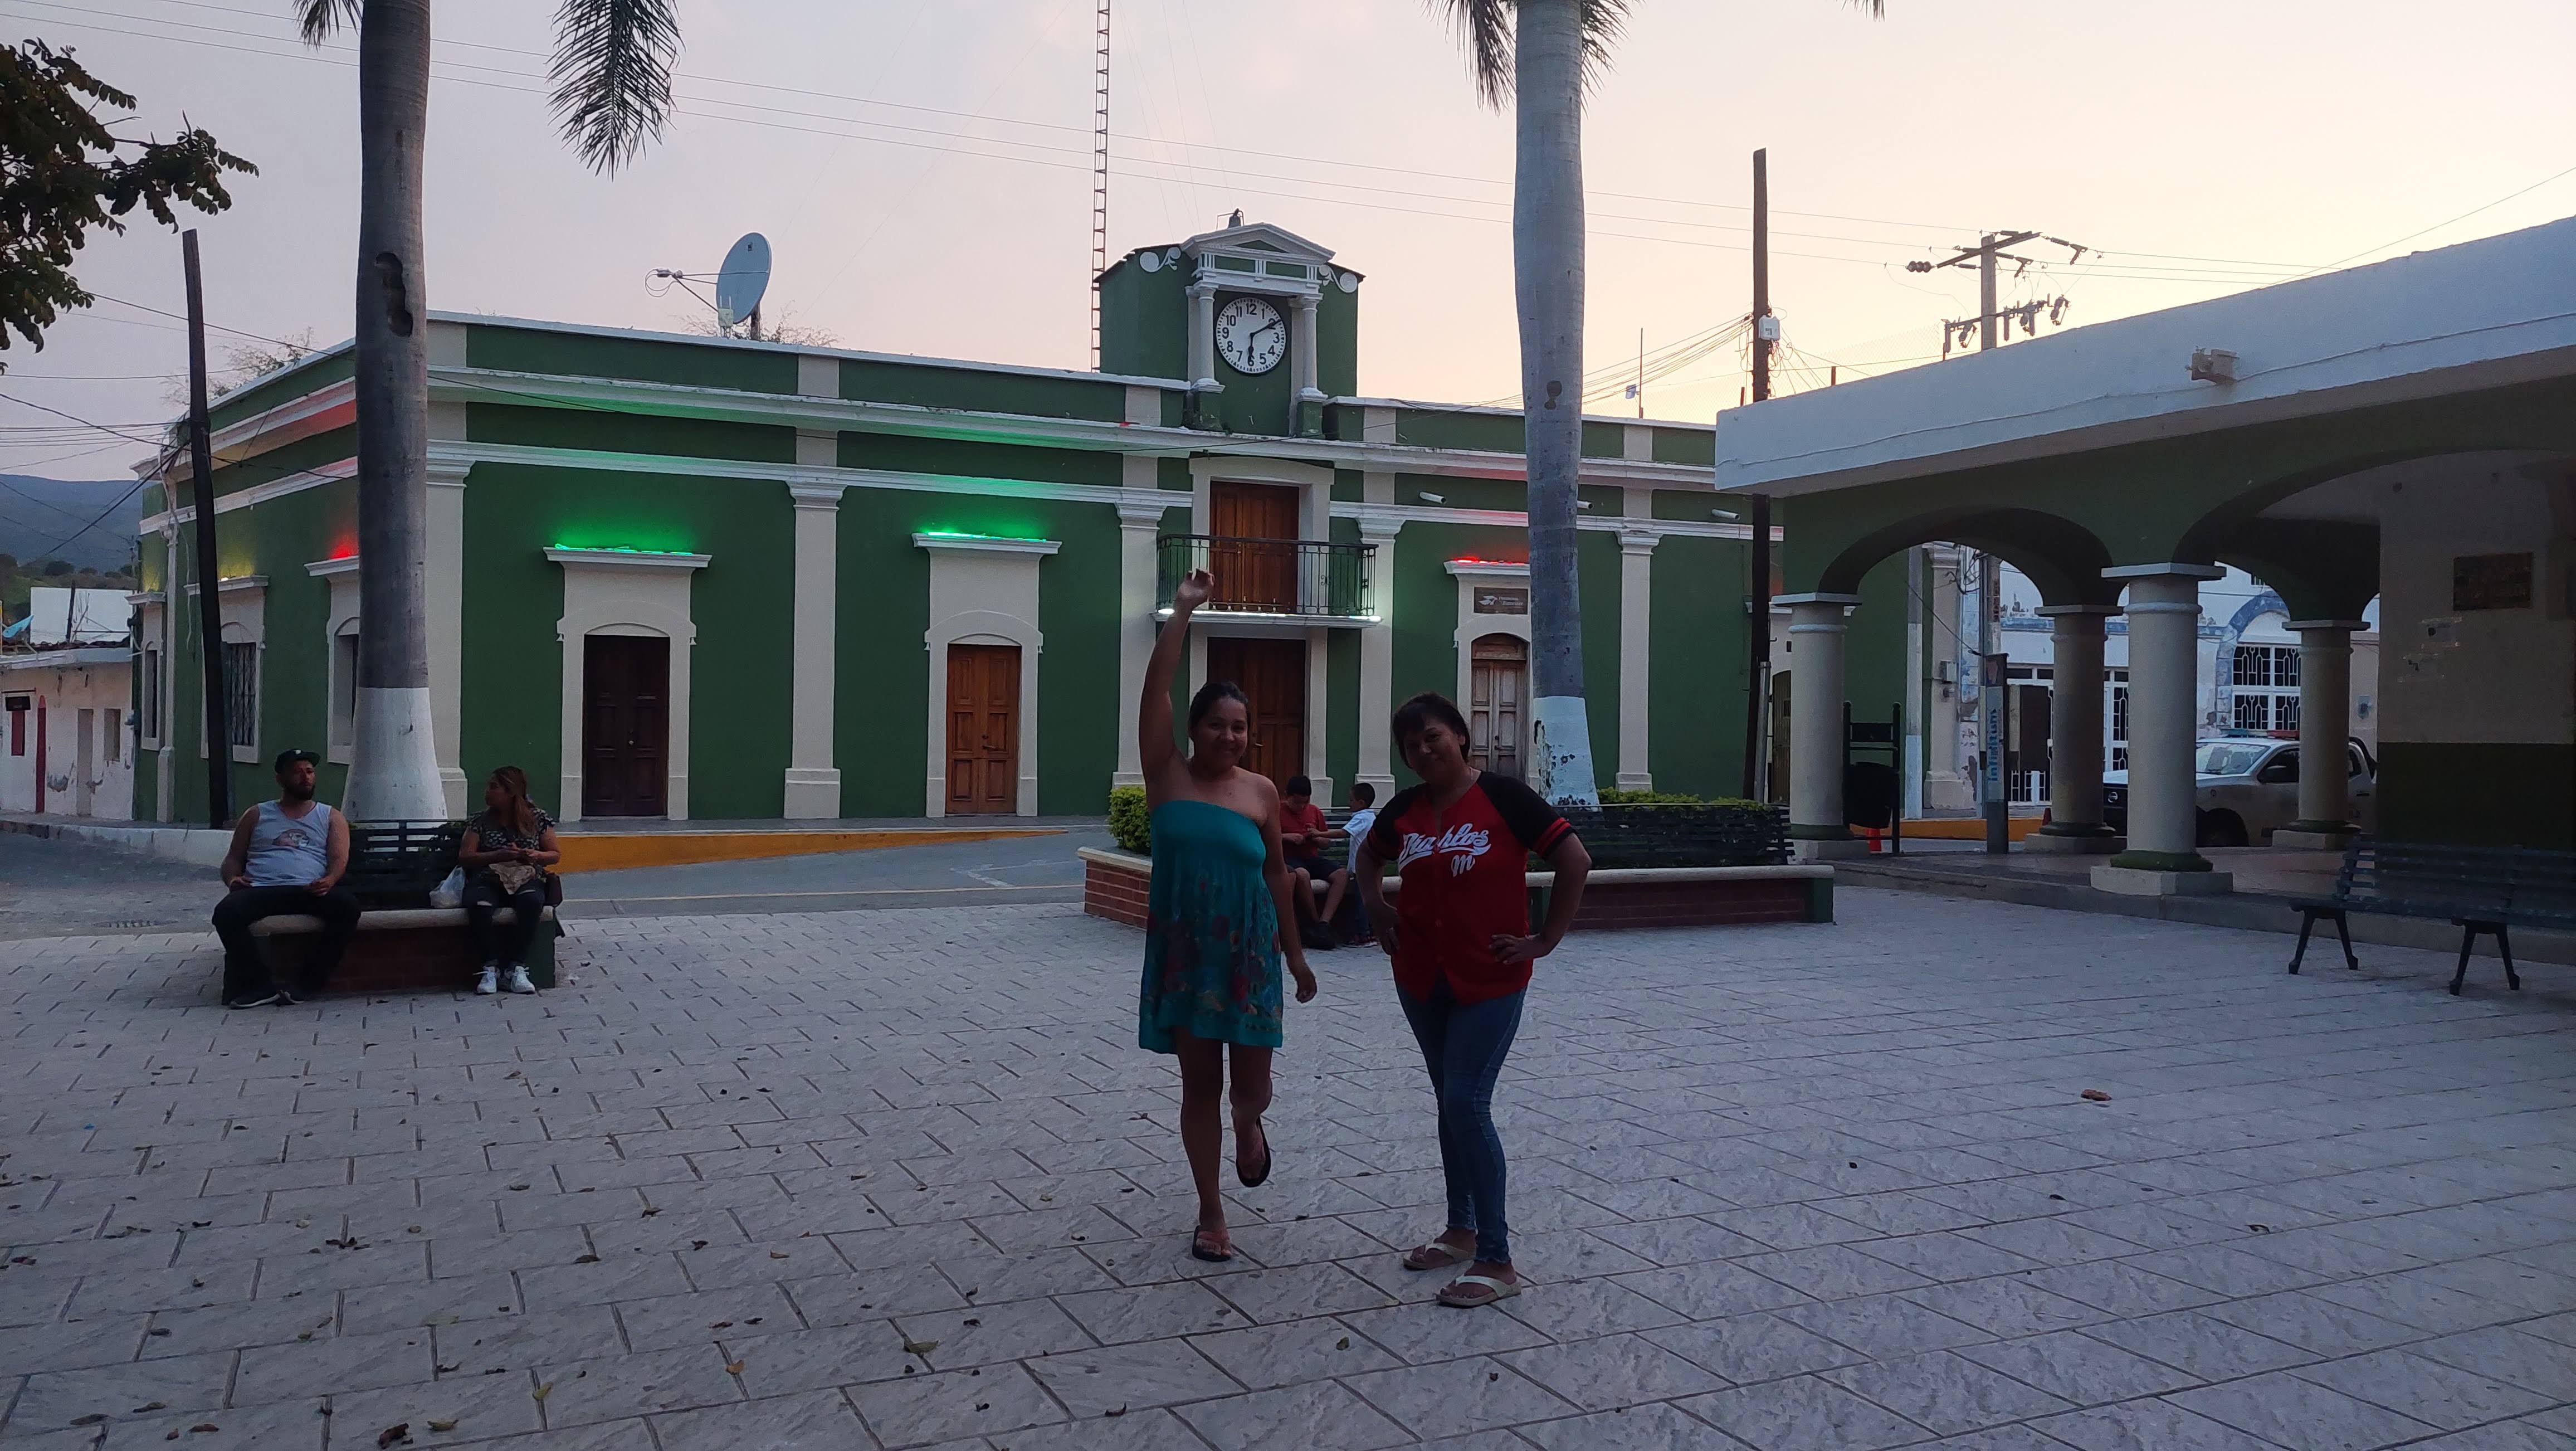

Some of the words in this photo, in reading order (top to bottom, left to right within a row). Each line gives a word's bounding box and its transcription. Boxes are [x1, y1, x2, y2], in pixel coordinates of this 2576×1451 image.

[1236, 306, 1242, 318] 11
[1246, 303, 1257, 315] 12
[1261, 308, 1265, 320] 1
[1226, 315, 1236, 327] 10
[1269, 318, 1276, 330] 2
[1222, 327, 1230, 339] 9
[1273, 332, 1280, 344] 3
[1227, 340, 1233, 353] 8
[1267, 344, 1276, 356] 4
[1236, 350, 1243, 362] 7
[1247, 354, 1255, 367] 6
[1259, 353, 1267, 364] 5
